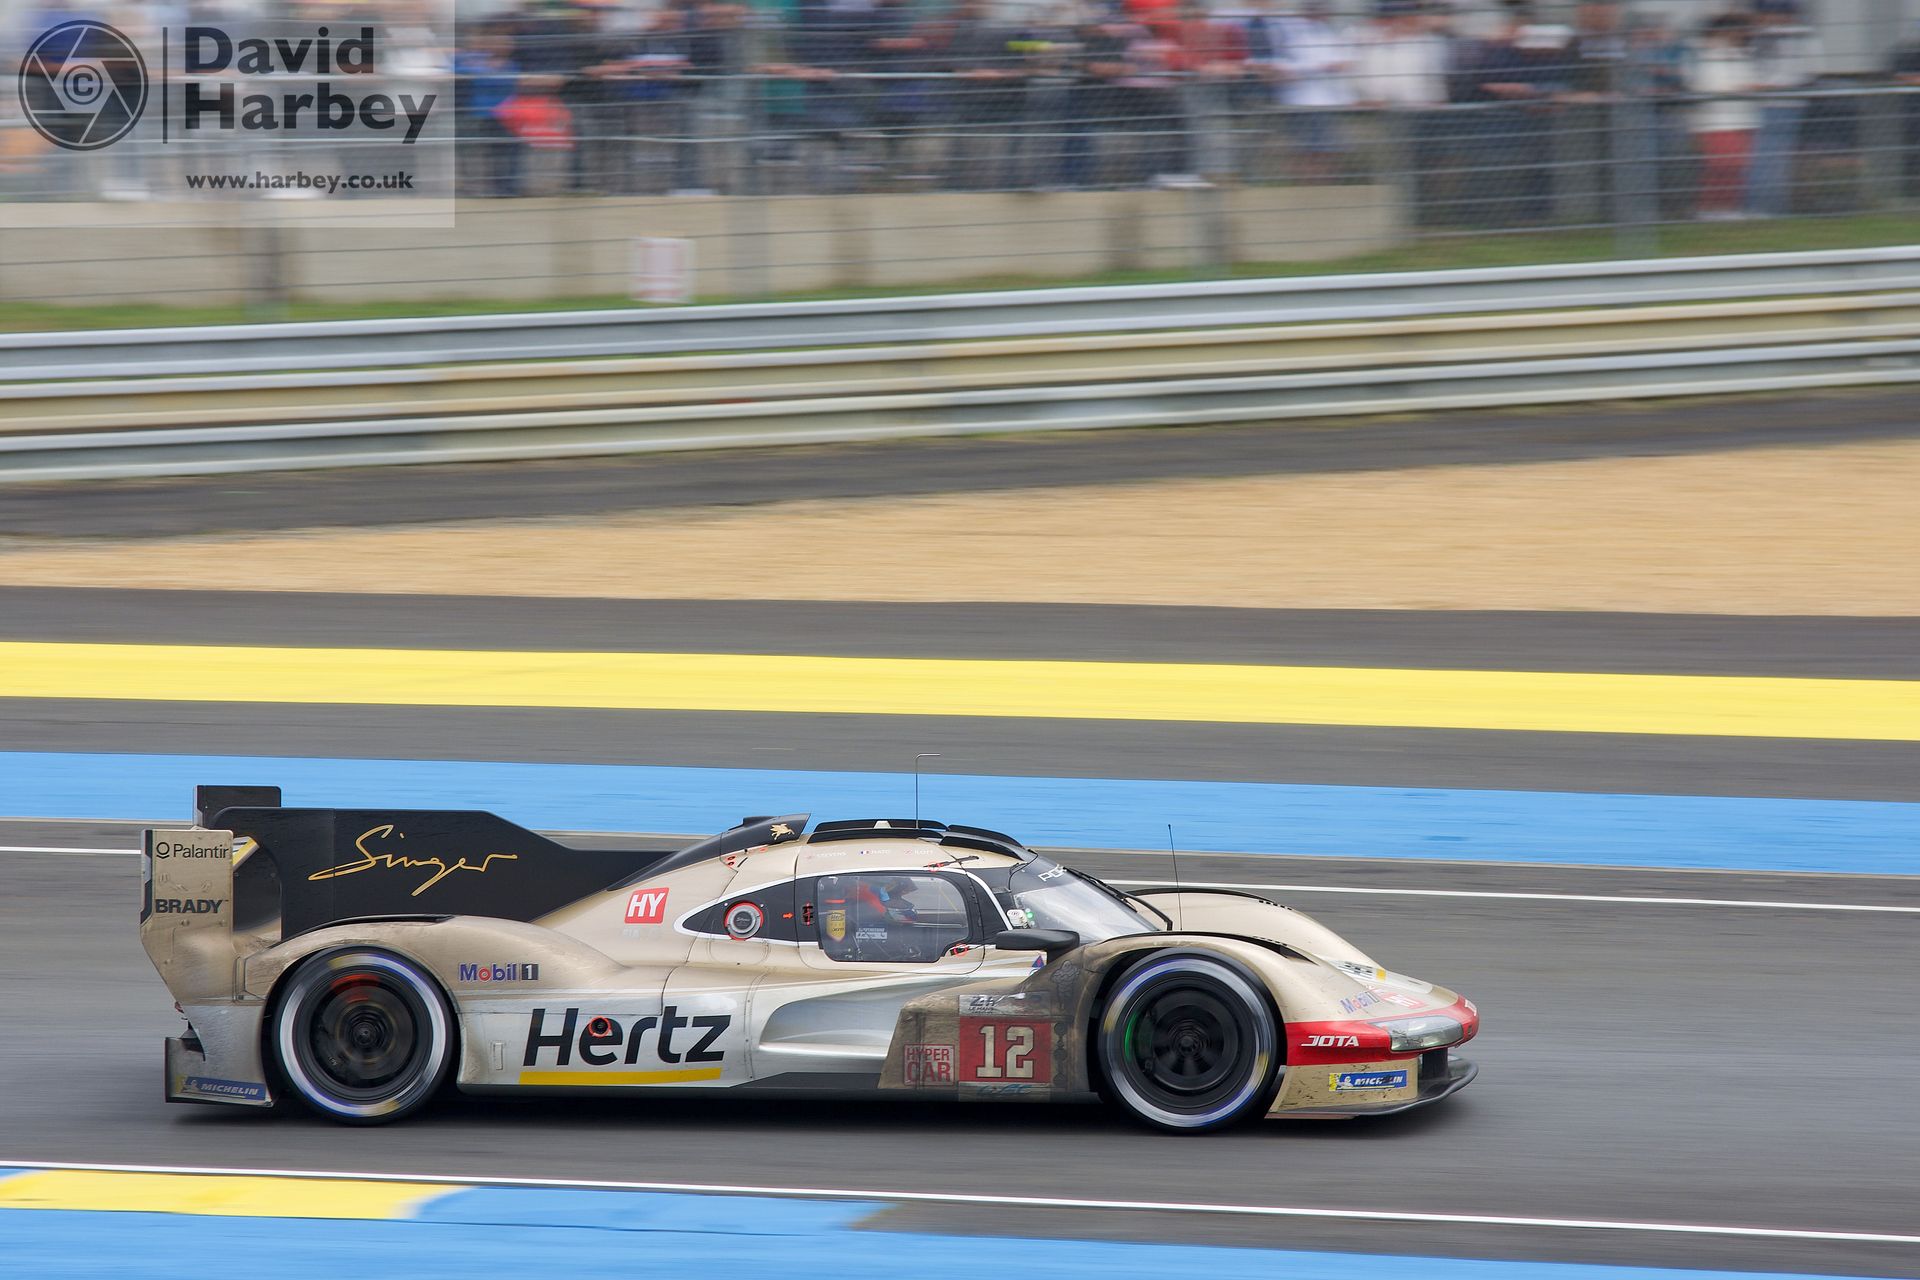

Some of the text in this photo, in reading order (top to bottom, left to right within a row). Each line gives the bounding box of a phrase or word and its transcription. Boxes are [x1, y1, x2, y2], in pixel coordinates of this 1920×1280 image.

[172, 843, 229, 859] Palantir
[308, 824, 518, 898] Singer
[155, 898, 223, 914] BRADY
[626, 893, 665, 917] HY
[460, 964, 517, 982] Mobil
[523, 1006, 731, 1066] Hertz
[1302, 1036, 1359, 1047] JOTA
[906, 1048, 950, 1062] HYPER
[975, 1024, 1035, 1079] 12
[906, 1062, 951, 1083] CAR
[200, 1083, 259, 1096] MICHELIN
